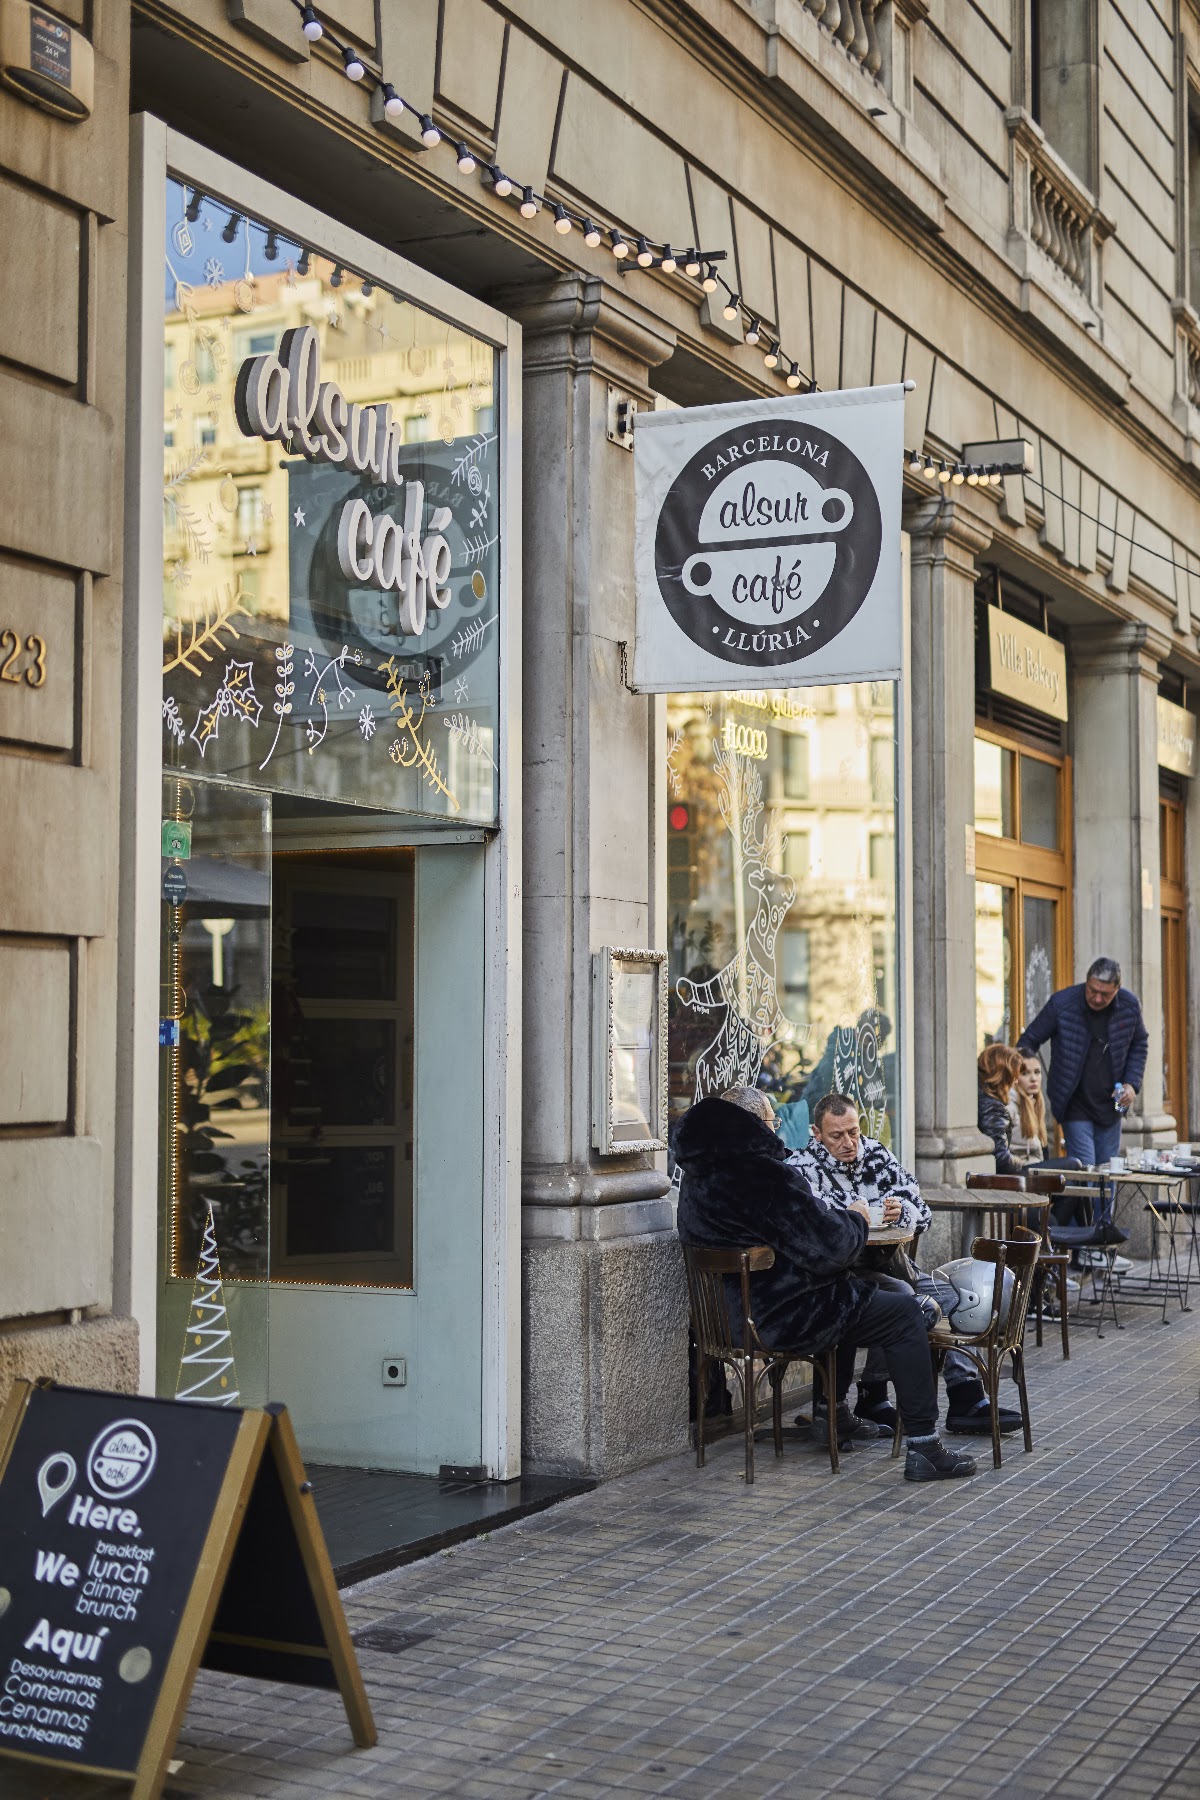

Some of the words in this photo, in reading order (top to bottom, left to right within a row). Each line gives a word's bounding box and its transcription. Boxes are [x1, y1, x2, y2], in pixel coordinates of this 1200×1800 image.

[243, 326, 403, 485] alsur
[700, 435, 830, 481] BARCELONA
[719, 481, 809, 529] alsur
[339, 481, 453, 636] café
[732, 555, 803, 614] café
[721, 622, 812, 652] LLÚRIA
[0, 629, 47, 689] 23
[997, 632, 1023, 676] Villa
[1025, 646, 1060, 703] Bakery
[68, 1494, 143, 1537] Here,
[35, 1550, 80, 1587] We
[88, 1554, 150, 1585] lunch
[96, 1540, 155, 1561] breakfast
[76, 1595, 137, 1621] brunch
[82, 1578, 143, 1603] dinner
[24, 1618, 110, 1664] Aquí
[5, 1675, 97, 1710] Comemos
[10, 1659, 103, 1689] Desayunamos
[0, 1696, 90, 1732] Cenamos
